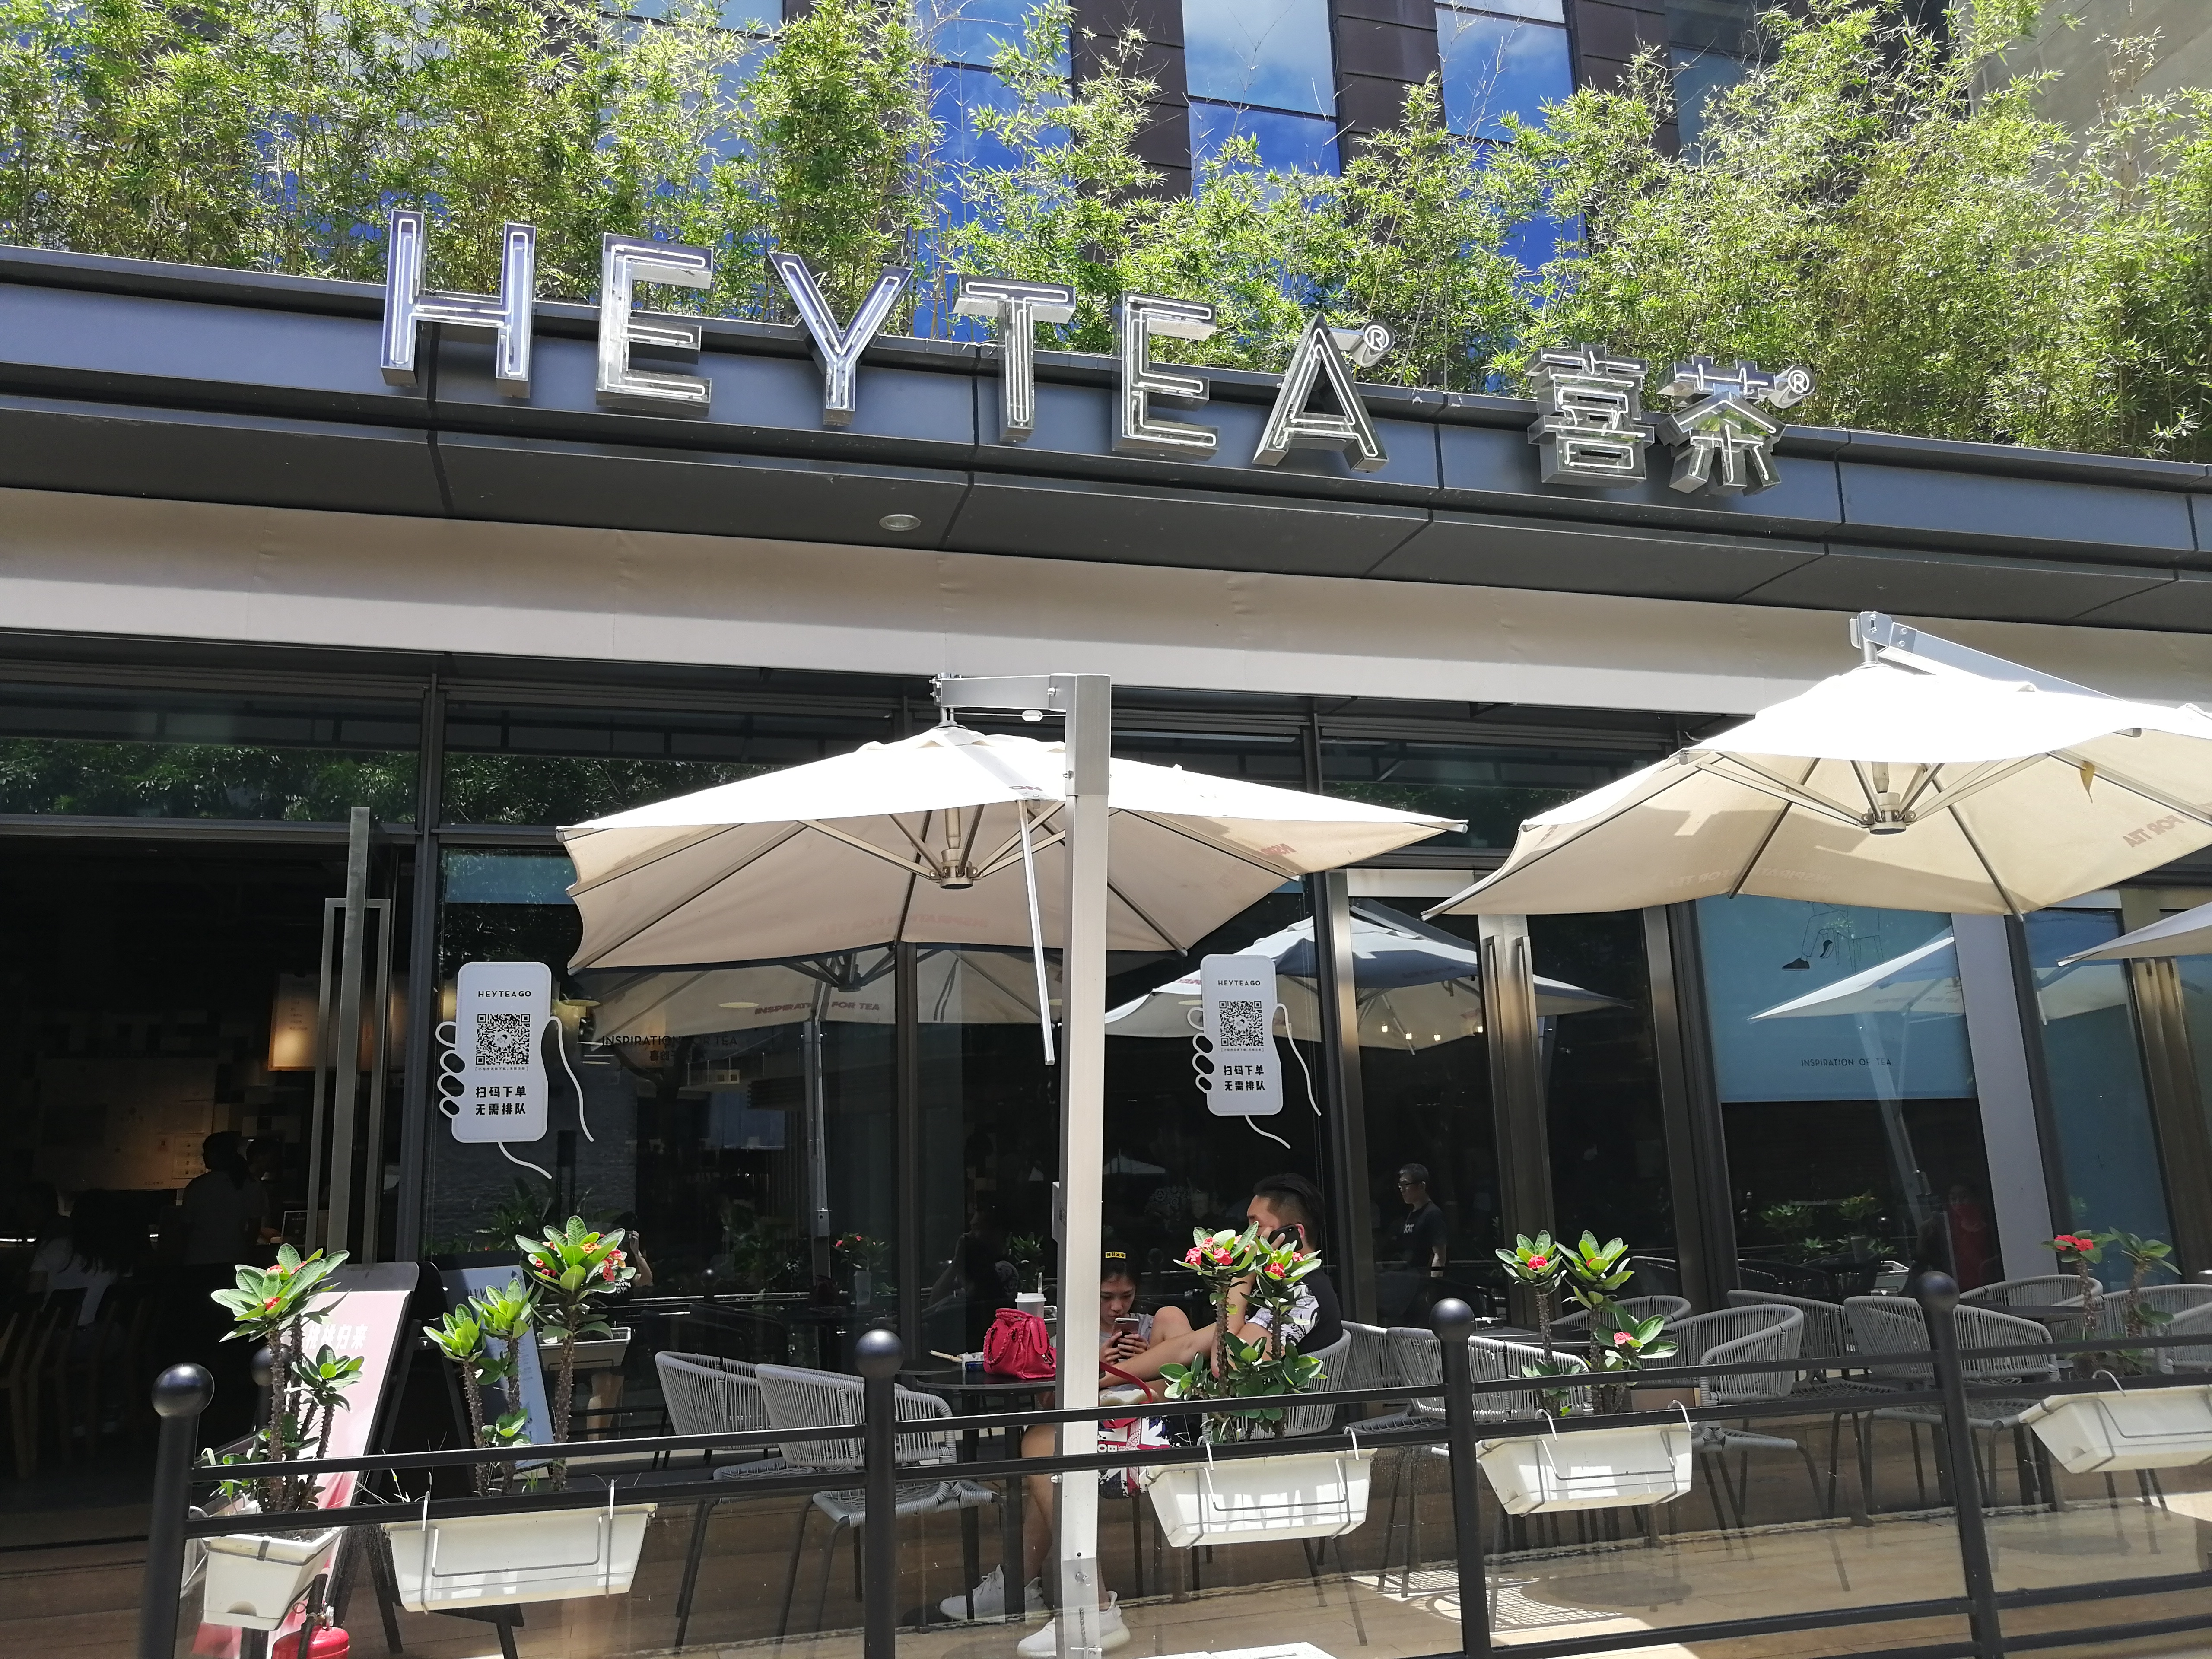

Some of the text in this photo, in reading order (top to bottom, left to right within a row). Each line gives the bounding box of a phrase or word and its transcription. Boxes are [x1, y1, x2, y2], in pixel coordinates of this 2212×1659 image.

[1525, 343, 1787, 496] 喜茶
[1801, 1058, 1854, 1067] INSPIRATION
[1224, 1065, 1264, 1076] 扫码下单
[476, 1085, 527, 1098] 扫码下单
[1224, 1080, 1265, 1091] 无需排队
[475, 1103, 526, 1116] 无需排队
